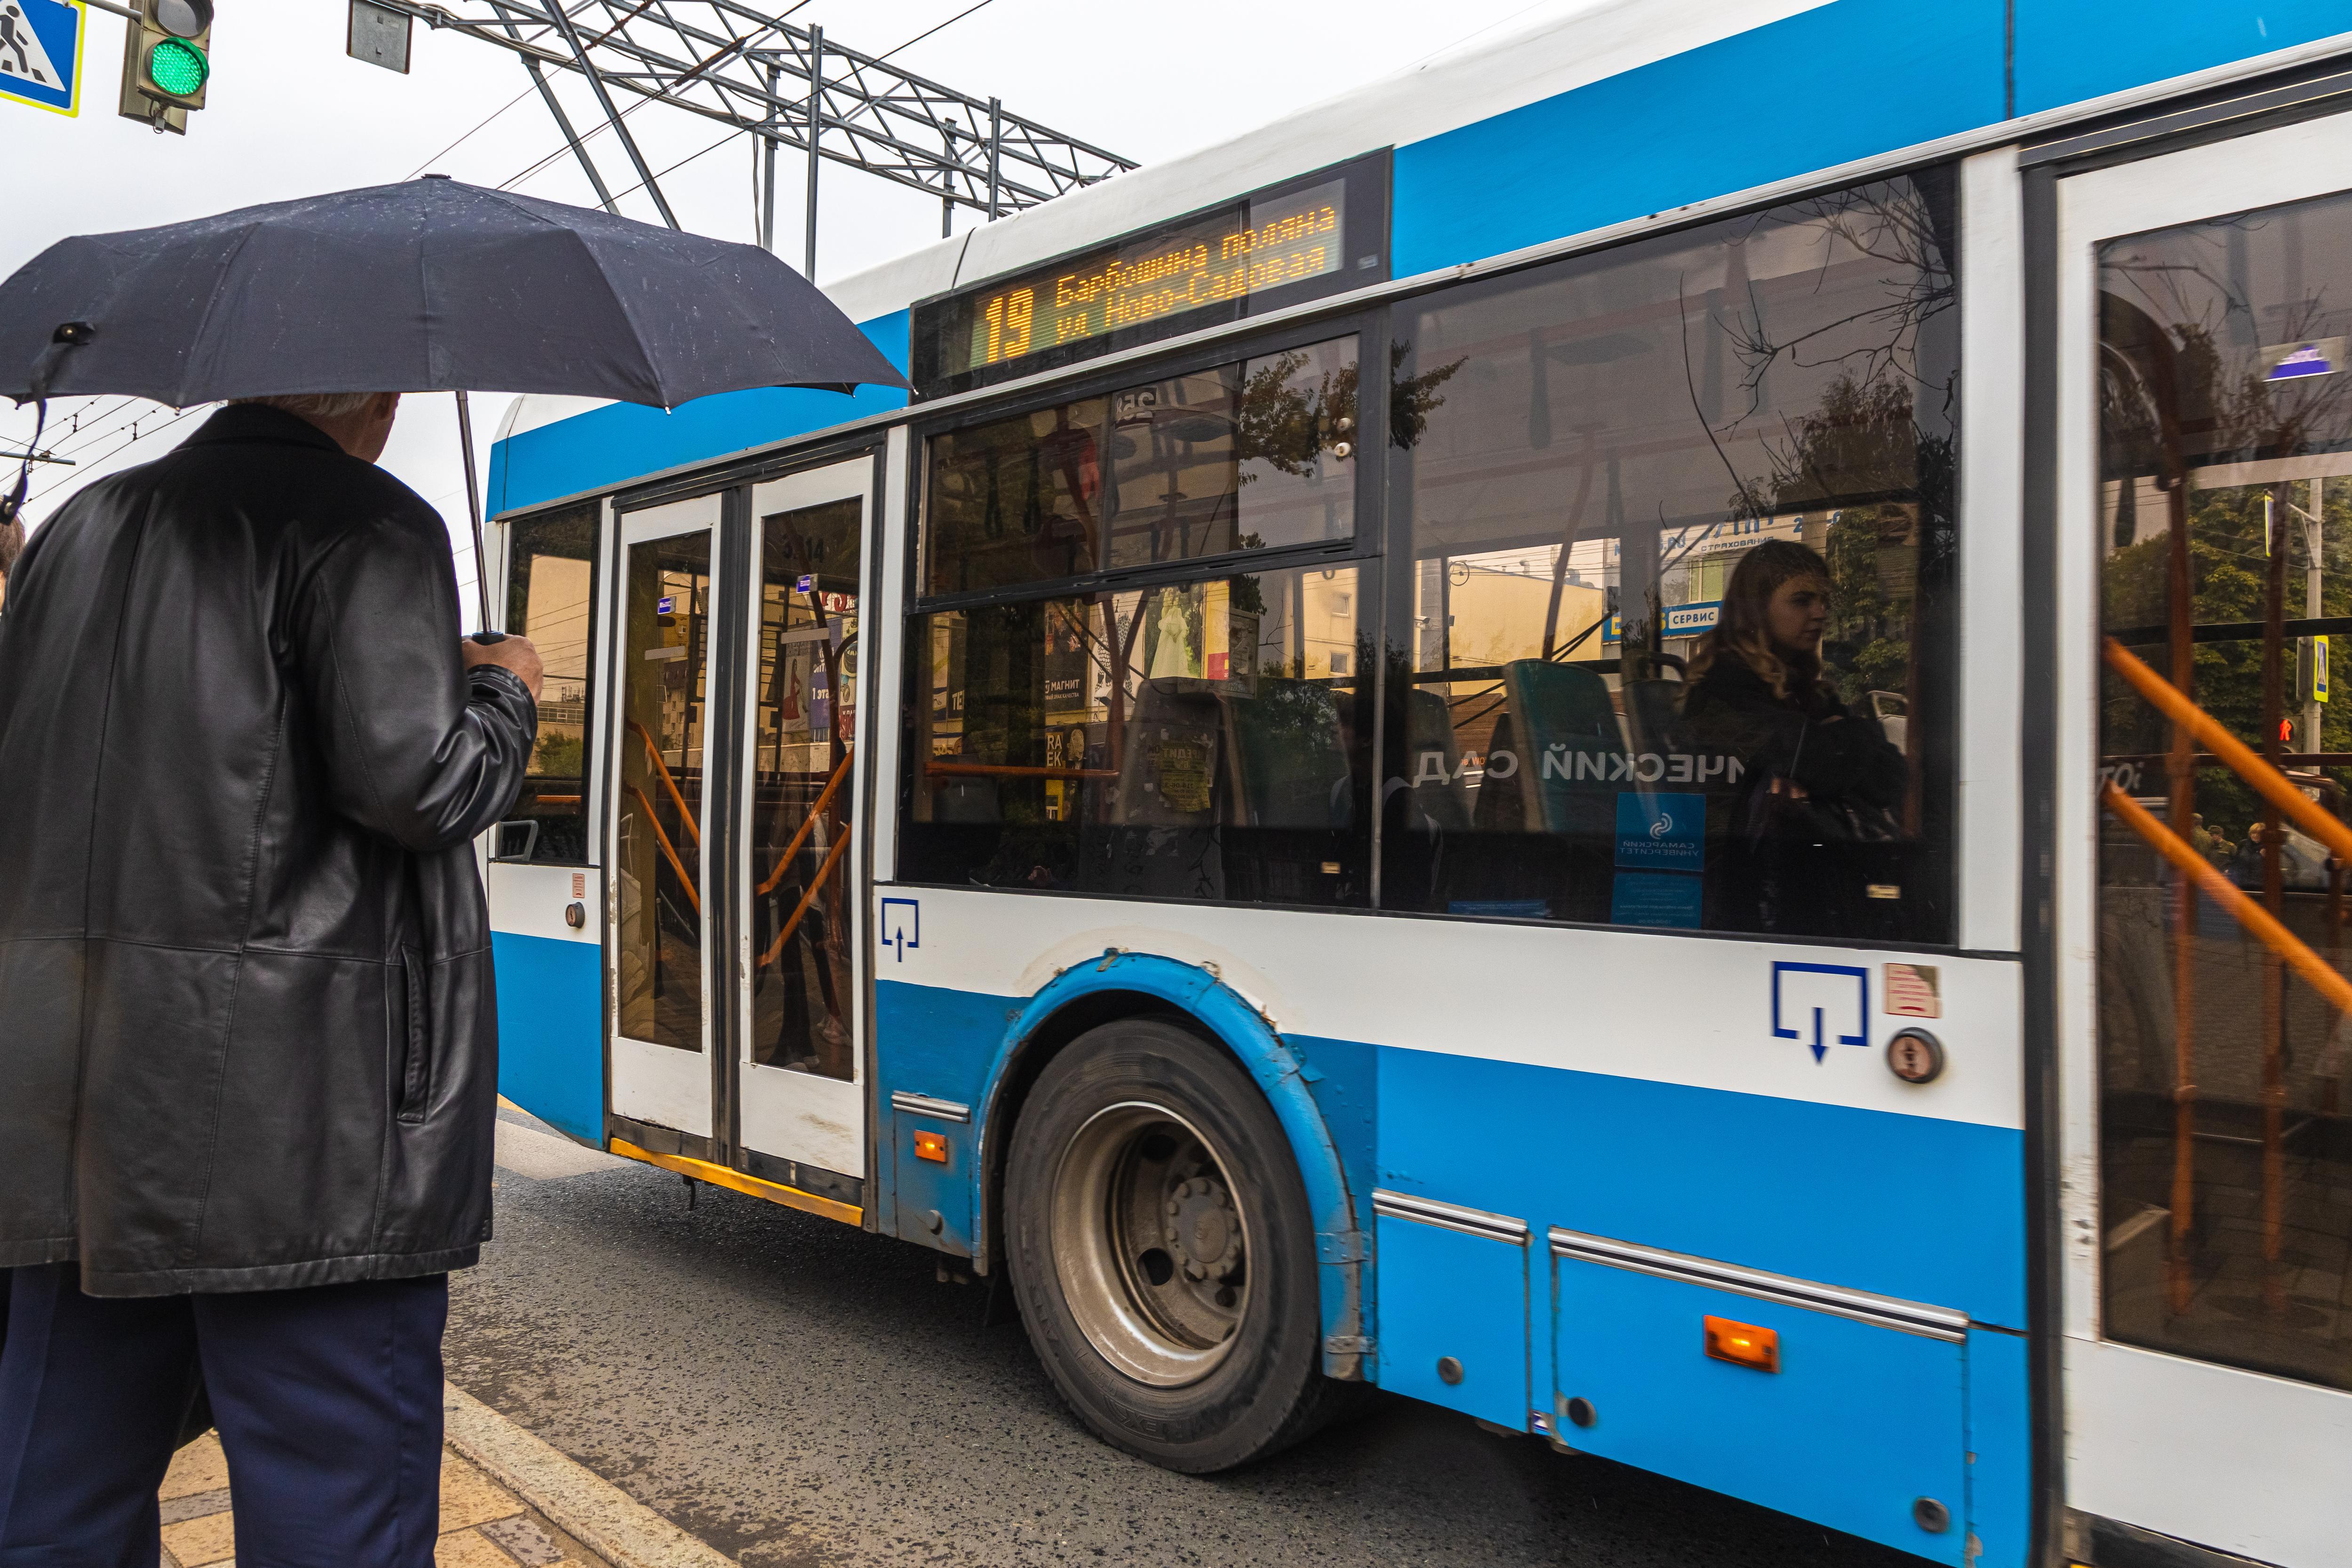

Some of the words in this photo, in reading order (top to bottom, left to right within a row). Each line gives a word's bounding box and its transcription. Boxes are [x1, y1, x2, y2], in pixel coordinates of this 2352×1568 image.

[1056, 245, 1208, 308] Барбошина
[1222, 207, 1335, 260] поляна
[1056, 313, 1091, 344] ул.
[1105, 247, 1325, 326] Ново-Садовая
[986, 288, 1033, 363] 19
[1673, 612, 1715, 625] СЕРВИС
[817, 689, 829, 700] эта
[1051, 679, 1081, 691] МАГНИТ
